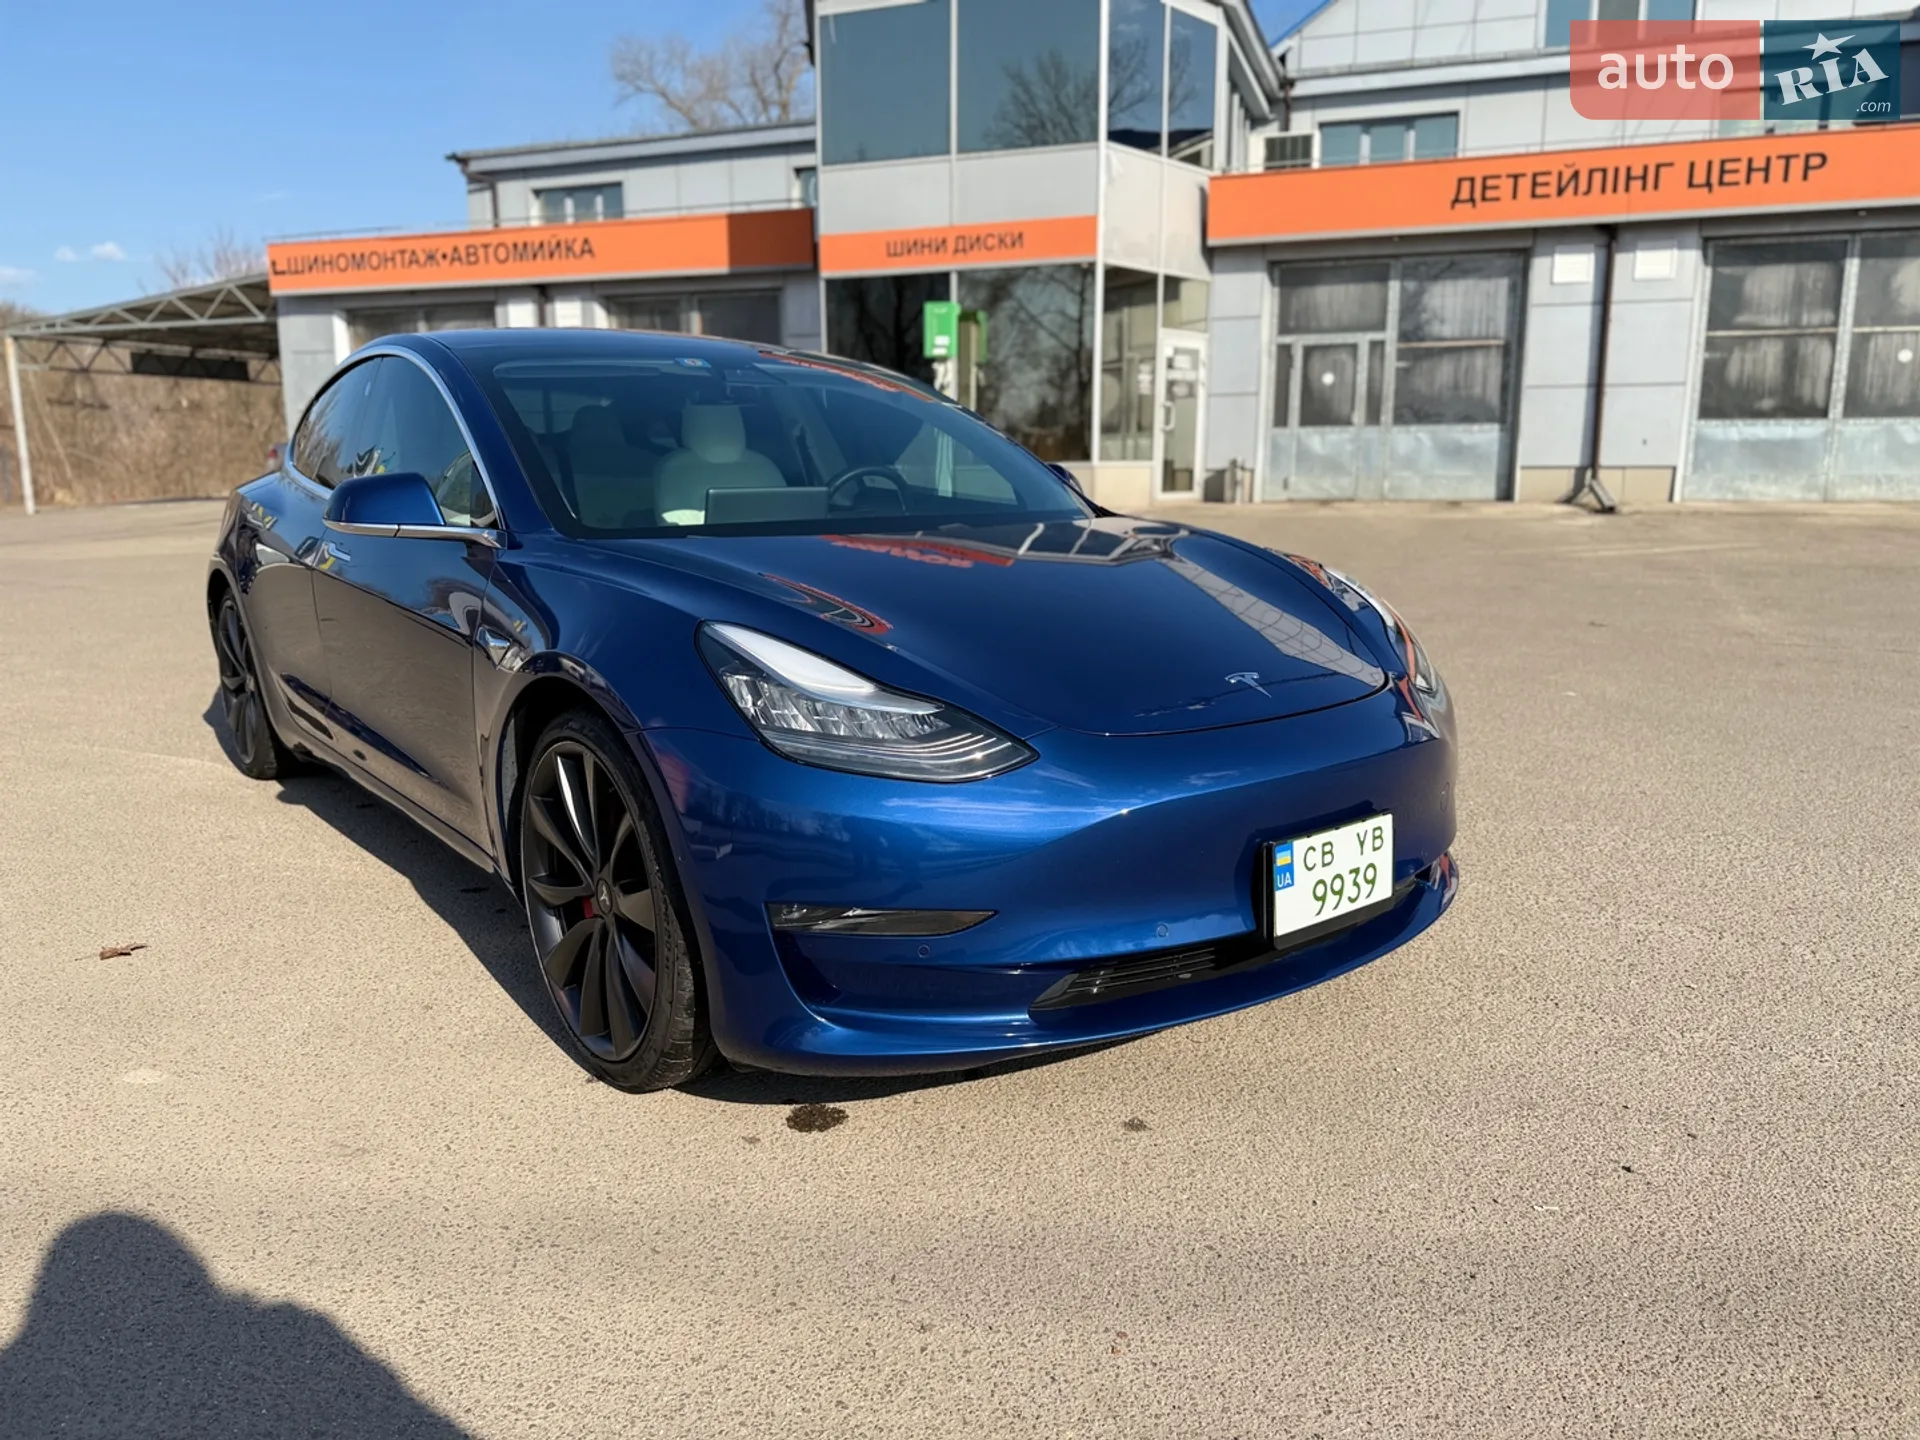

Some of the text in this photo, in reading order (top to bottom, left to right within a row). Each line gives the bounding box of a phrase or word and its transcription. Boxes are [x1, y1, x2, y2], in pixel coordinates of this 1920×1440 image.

[1450, 152, 1828, 210] ДЕТЕЙЛІНГ ЦЕНТР
[885, 231, 1024, 258] ШИНИ ДИСКИ
[1303, 826, 1384, 872] CB YB
[1277, 871, 1292, 888] UA
[1312, 862, 1378, 917] 9939
